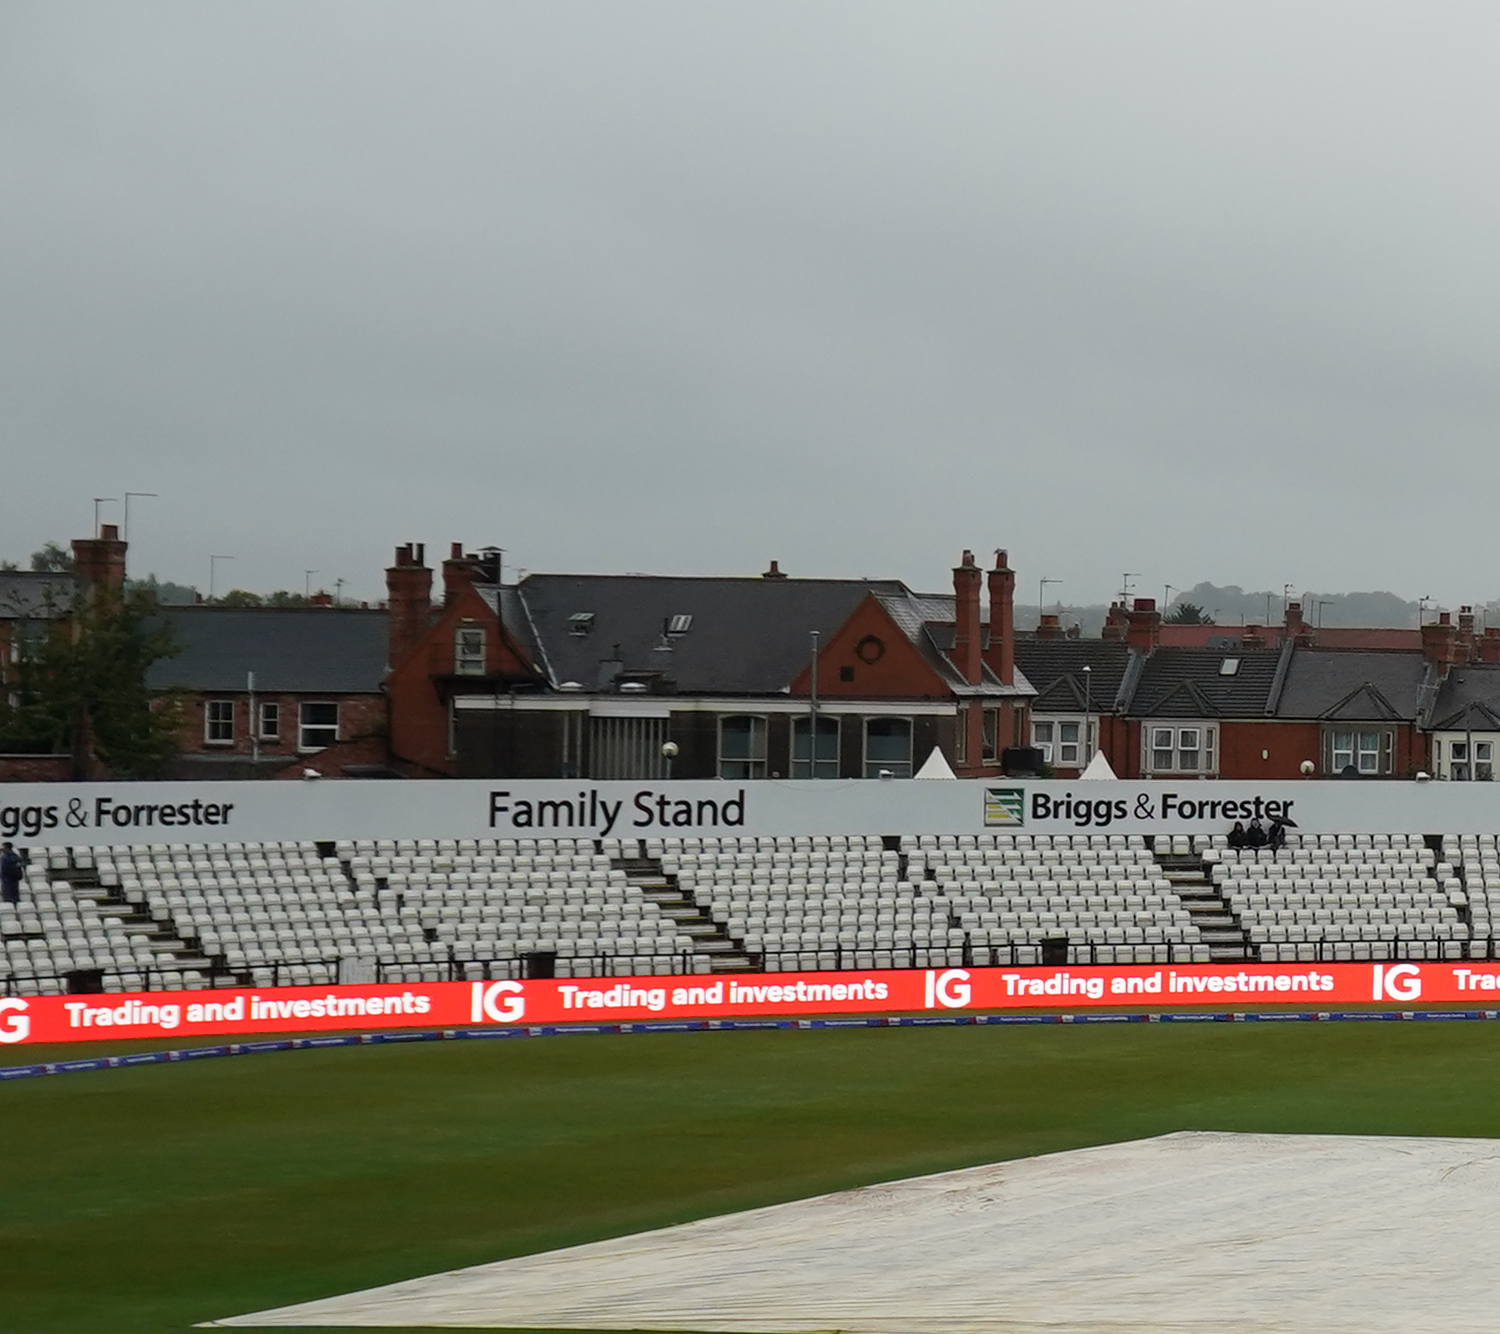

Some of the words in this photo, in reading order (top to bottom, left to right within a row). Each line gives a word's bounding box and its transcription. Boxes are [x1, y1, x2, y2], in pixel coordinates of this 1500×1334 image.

[66, 798, 87, 828] &
[96, 798, 233, 826] Forrester
[489, 790, 623, 835] Family
[633, 789, 746, 828] Stand
[1031, 792, 1128, 828] Briggs
[1134, 793, 1154, 819] &
[1161, 793, 1294, 820] Forrester
[471, 982, 525, 1022] IG
[557, 983, 666, 1011] Trading
[671, 981, 723, 1005] and
[729, 979, 888, 1004] investments
[924, 970, 971, 1008] IG
[1001, 972, 1104, 999] Trading
[1110, 971, 1162, 994] and
[1169, 971, 1334, 993] investments
[1372, 965, 1422, 1000] IG
[64, 999, 180, 1029] Trading
[186, 995, 244, 1022] and
[251, 991, 431, 1020] investments
